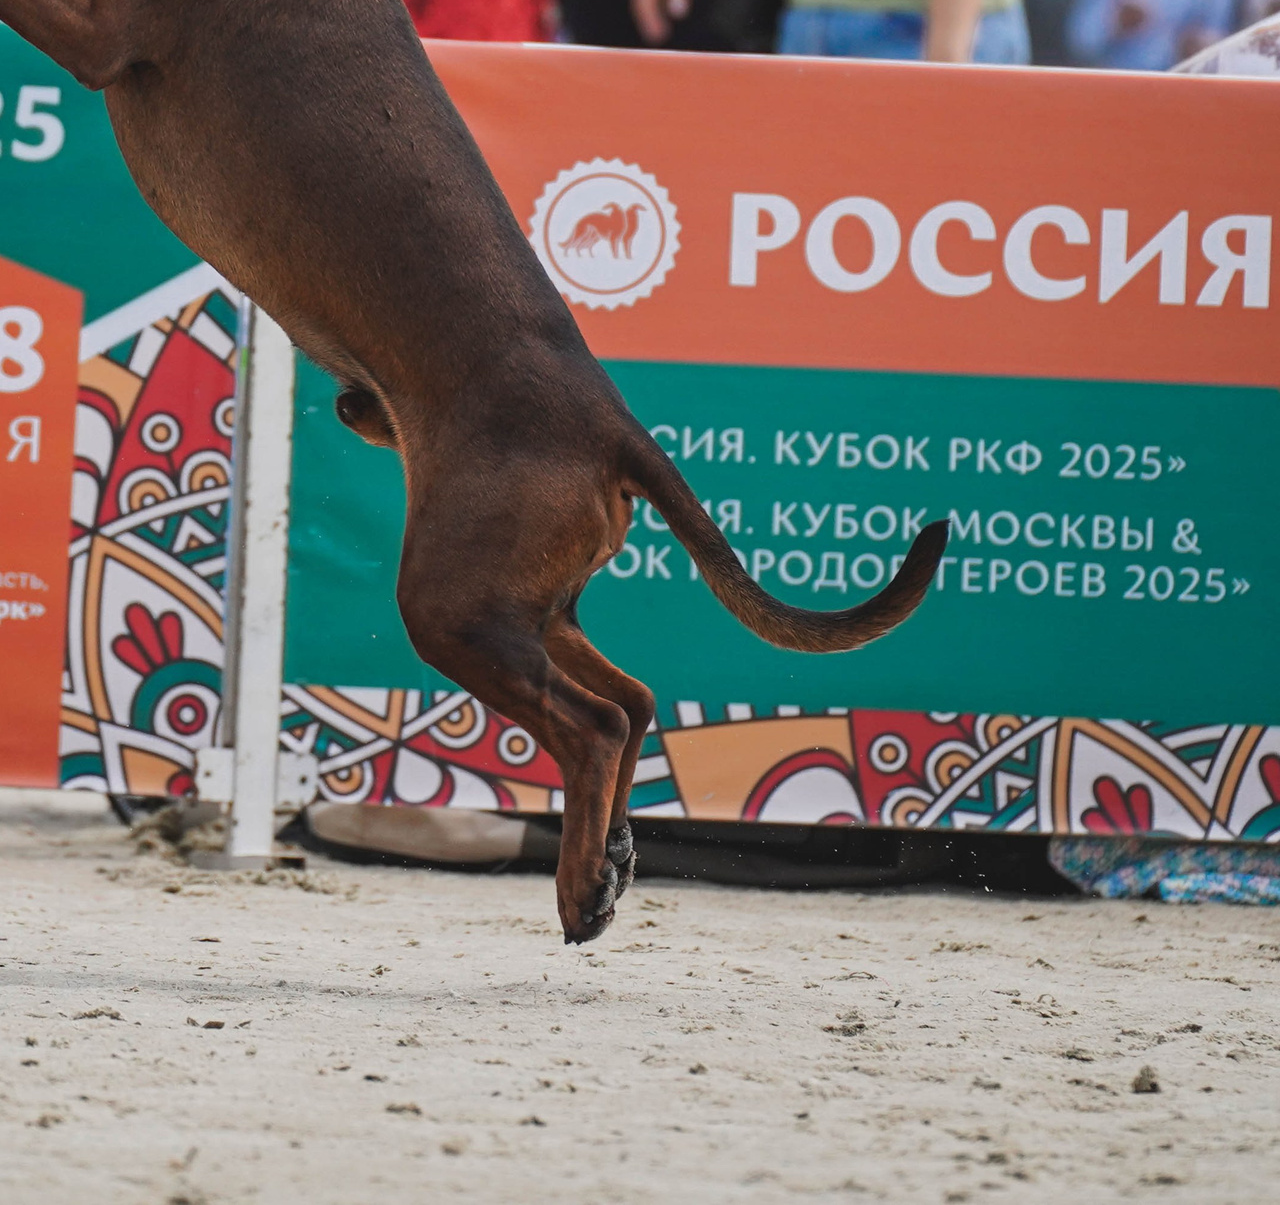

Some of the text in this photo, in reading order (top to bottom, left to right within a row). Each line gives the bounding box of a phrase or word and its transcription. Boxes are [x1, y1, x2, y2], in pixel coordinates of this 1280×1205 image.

[729, 192, 1273, 308] РОССИЯ
[774, 430, 930, 471] КУБОК
[948, 437, 1043, 475] РКФ
[1058, 442, 1187, 481] 2025»
[772, 500, 927, 542] КУБОК
[948, 508, 1154, 553] МОСКВЫ
[1171, 517, 1203, 556] &
[935, 555, 1107, 599] ГЕРОЕВ
[1123, 564, 1251, 603] 2025»
